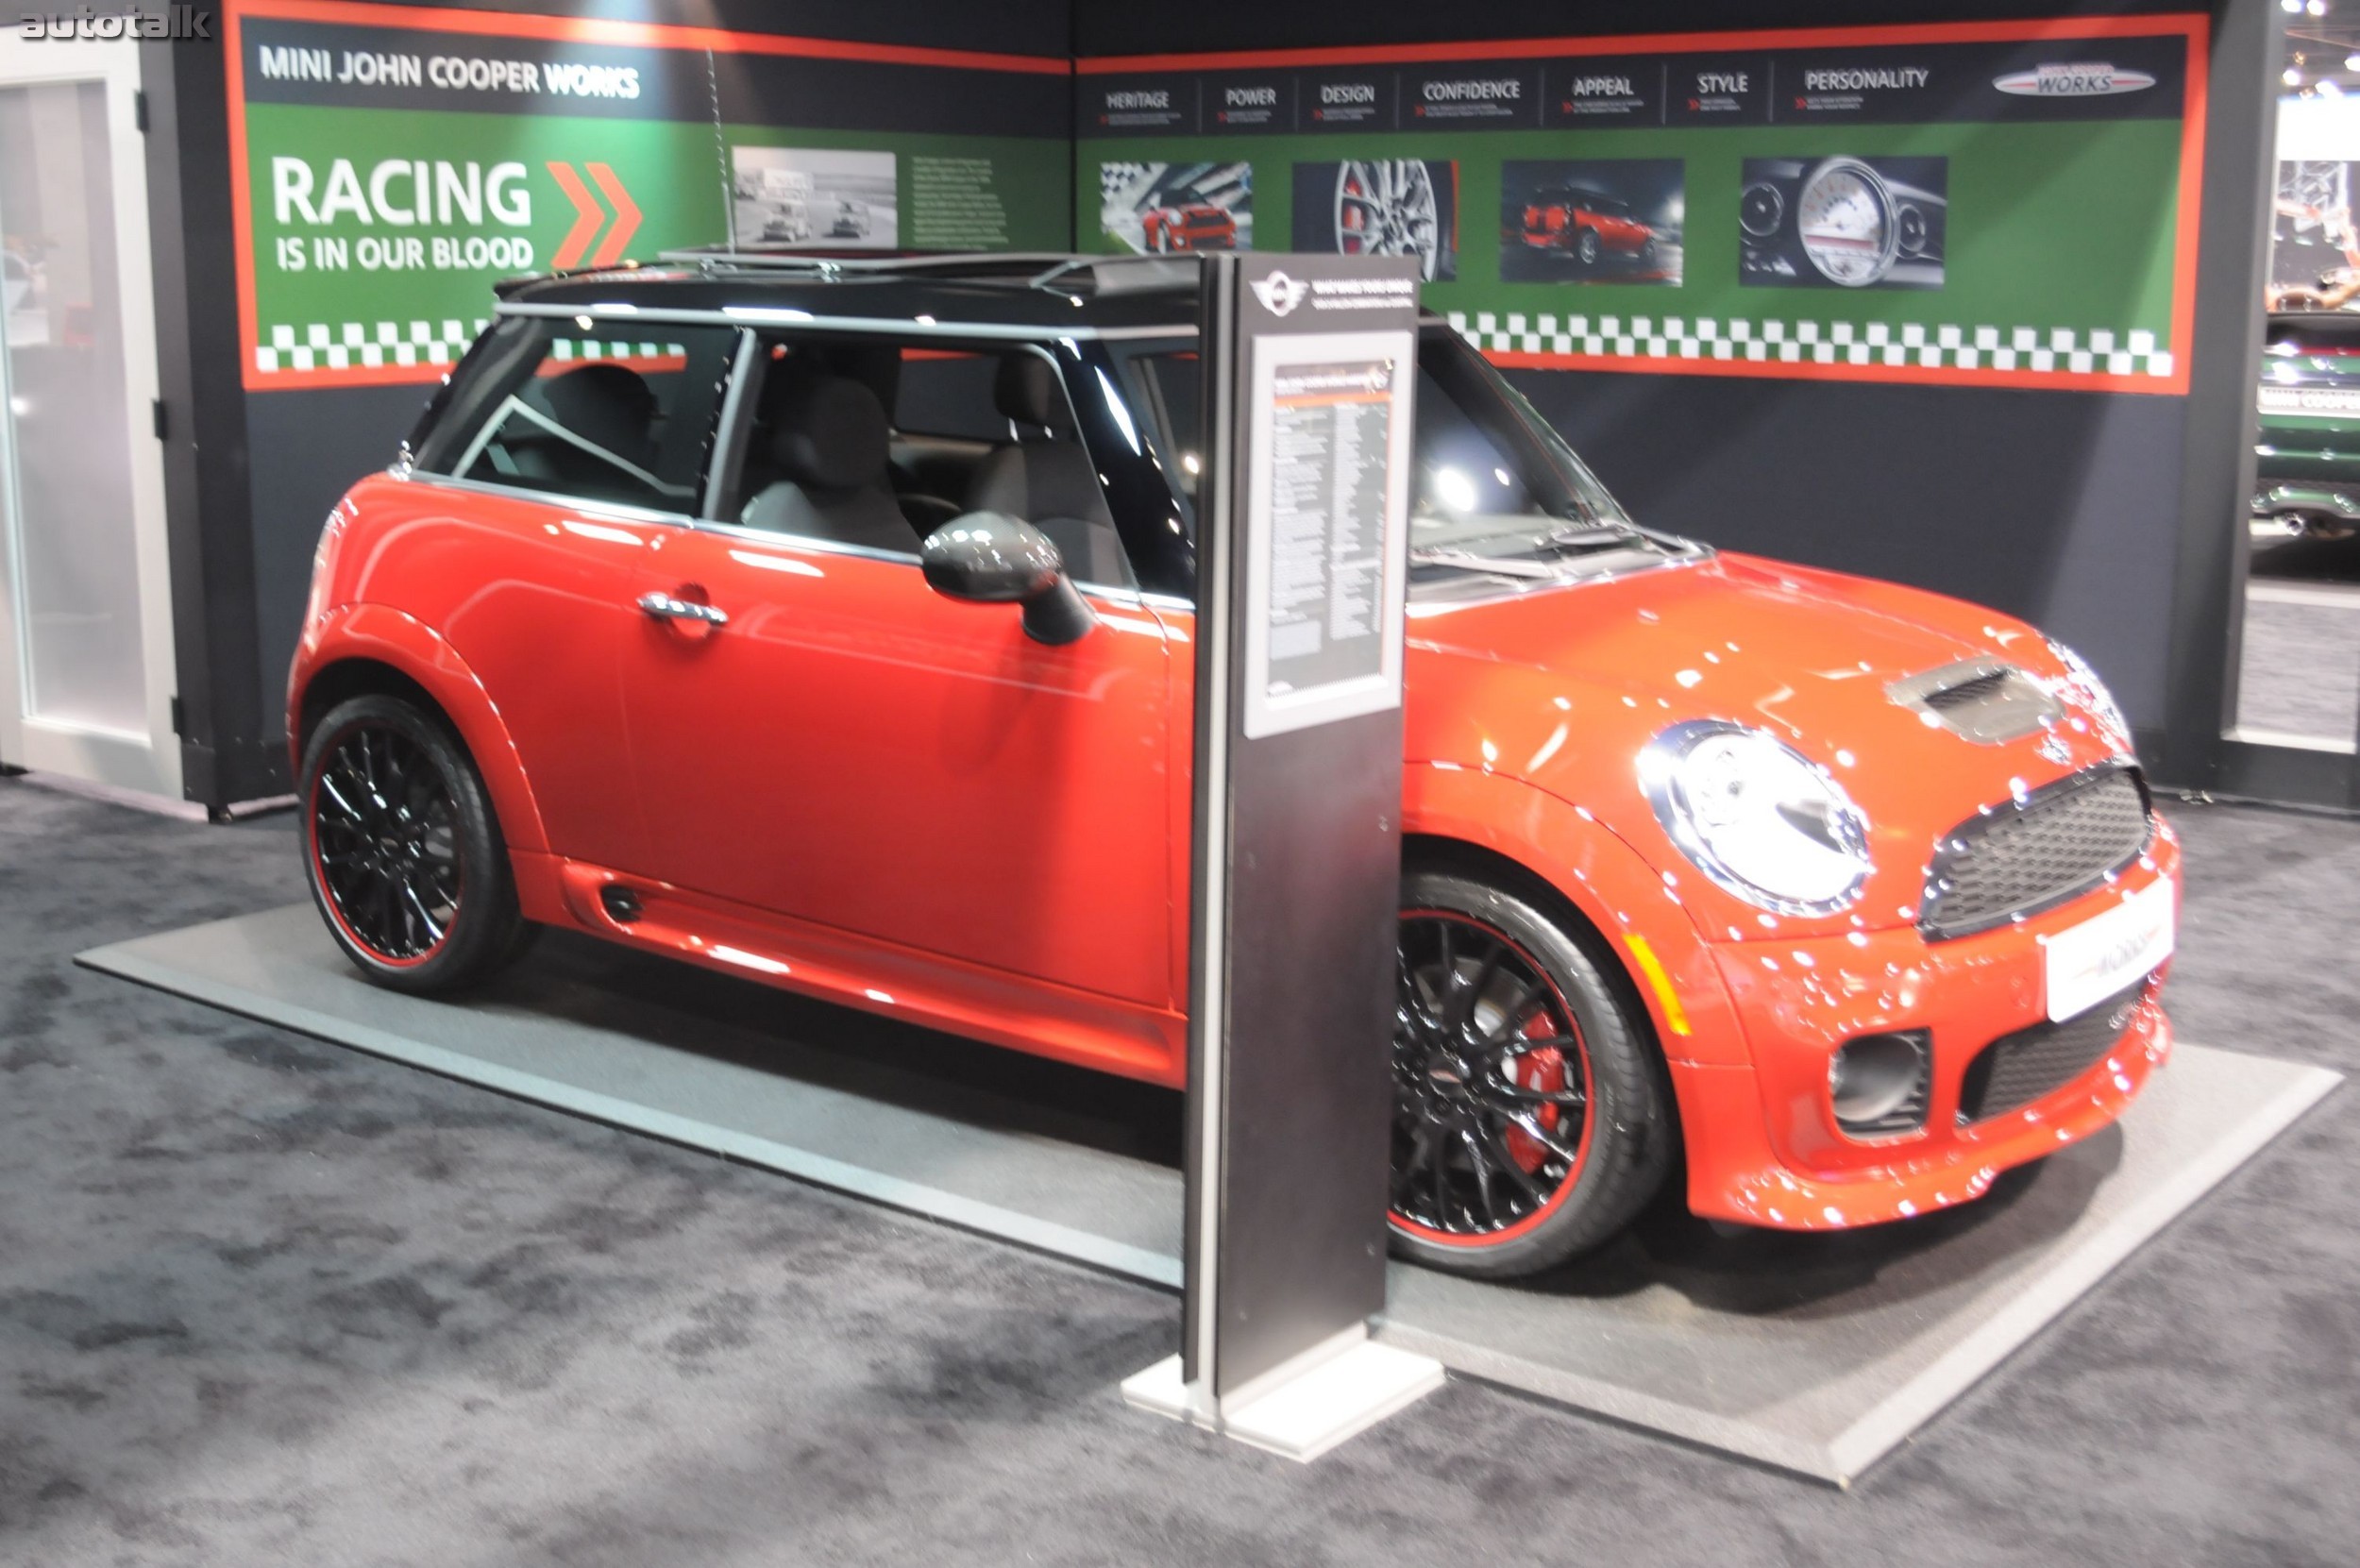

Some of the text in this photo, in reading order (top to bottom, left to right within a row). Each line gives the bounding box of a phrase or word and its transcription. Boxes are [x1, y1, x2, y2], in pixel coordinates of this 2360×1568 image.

[259, 44, 641, 99] MINI JOHN COOPER WORKS
[1696, 71, 1748, 93] STYLE
[1805, 66, 1930, 91] PERSONALITY
[1321, 85, 1374, 104] DESIGN
[1423, 79, 1521, 101] CONFIDENCE
[1573, 76, 1634, 96] APPEAL
[2037, 76, 2114, 93] WORKS
[1105, 92, 1170, 109] HERITAGE
[1225, 88, 1276, 107] POWER
[272, 156, 531, 227] RACING
[276, 237, 534, 272] IS IN OUR BLOOD
